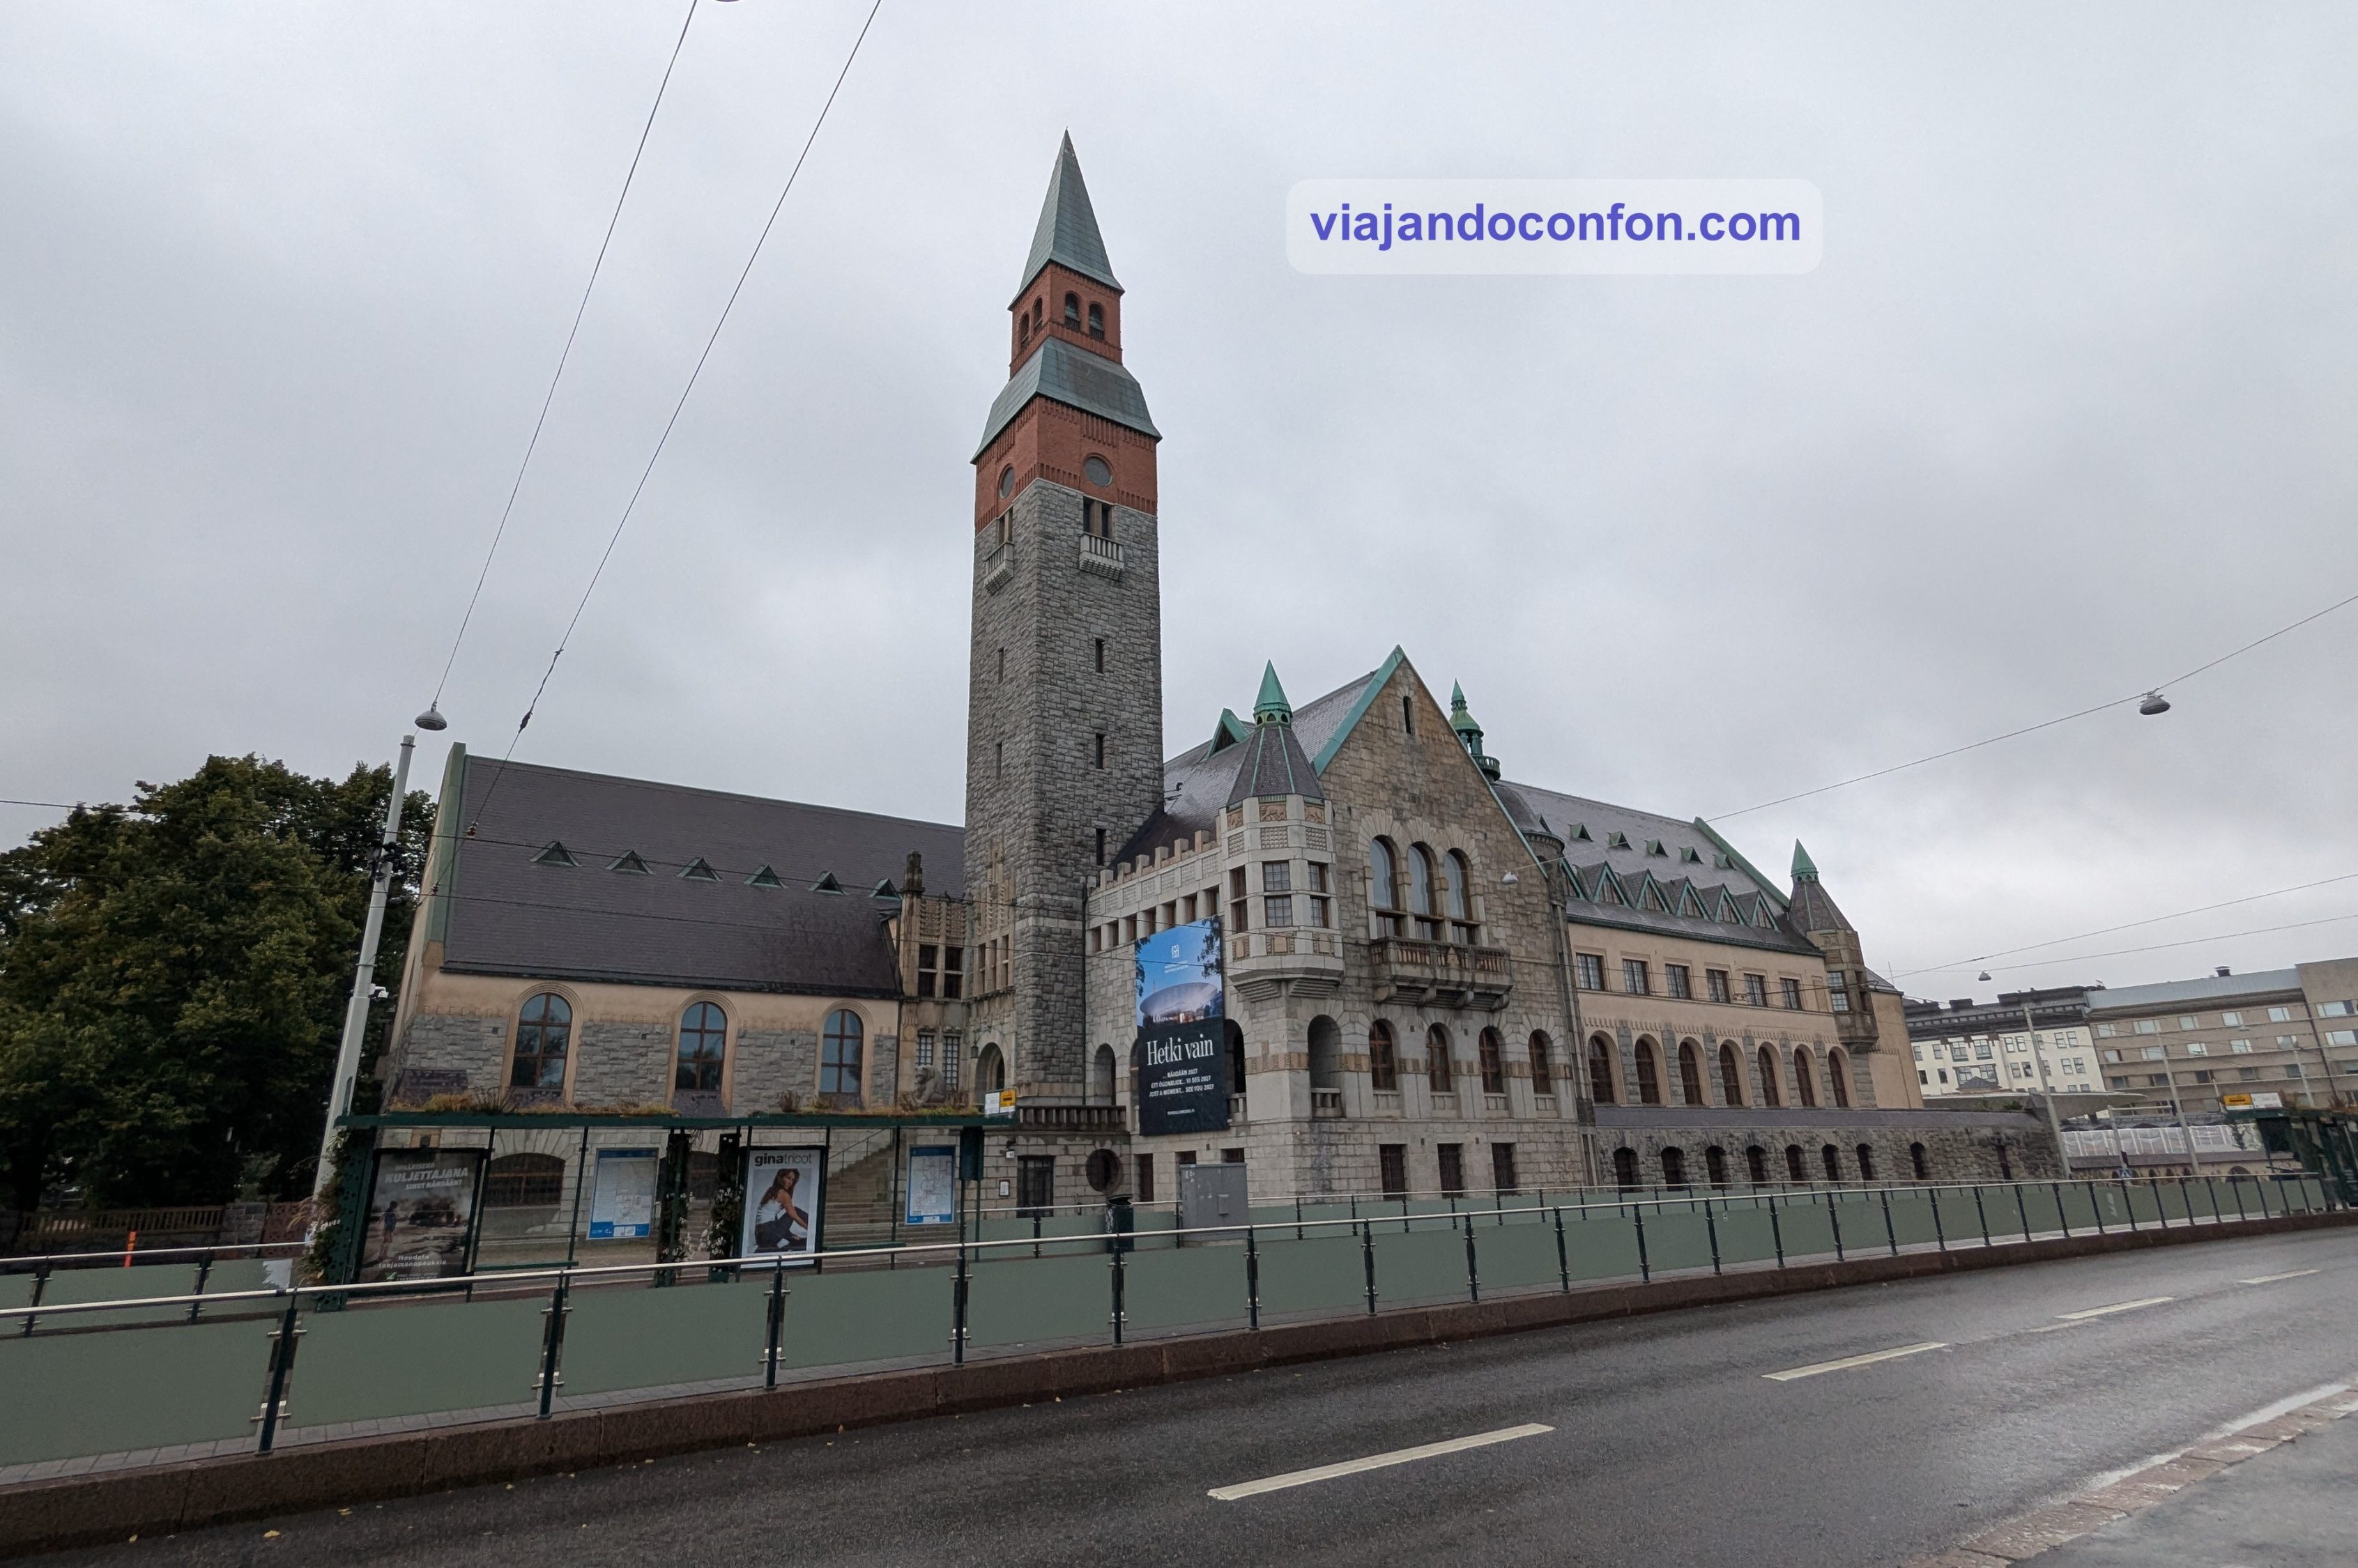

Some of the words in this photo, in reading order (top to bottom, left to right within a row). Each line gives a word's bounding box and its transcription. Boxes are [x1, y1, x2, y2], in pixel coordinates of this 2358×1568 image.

[1147, 1037, 1183, 1066] Hetki
[1184, 1033, 1214, 1059] vain
[754, 1153, 812, 1167] ginatricot
[384, 1167, 468, 1183] KULJETTAJANA
